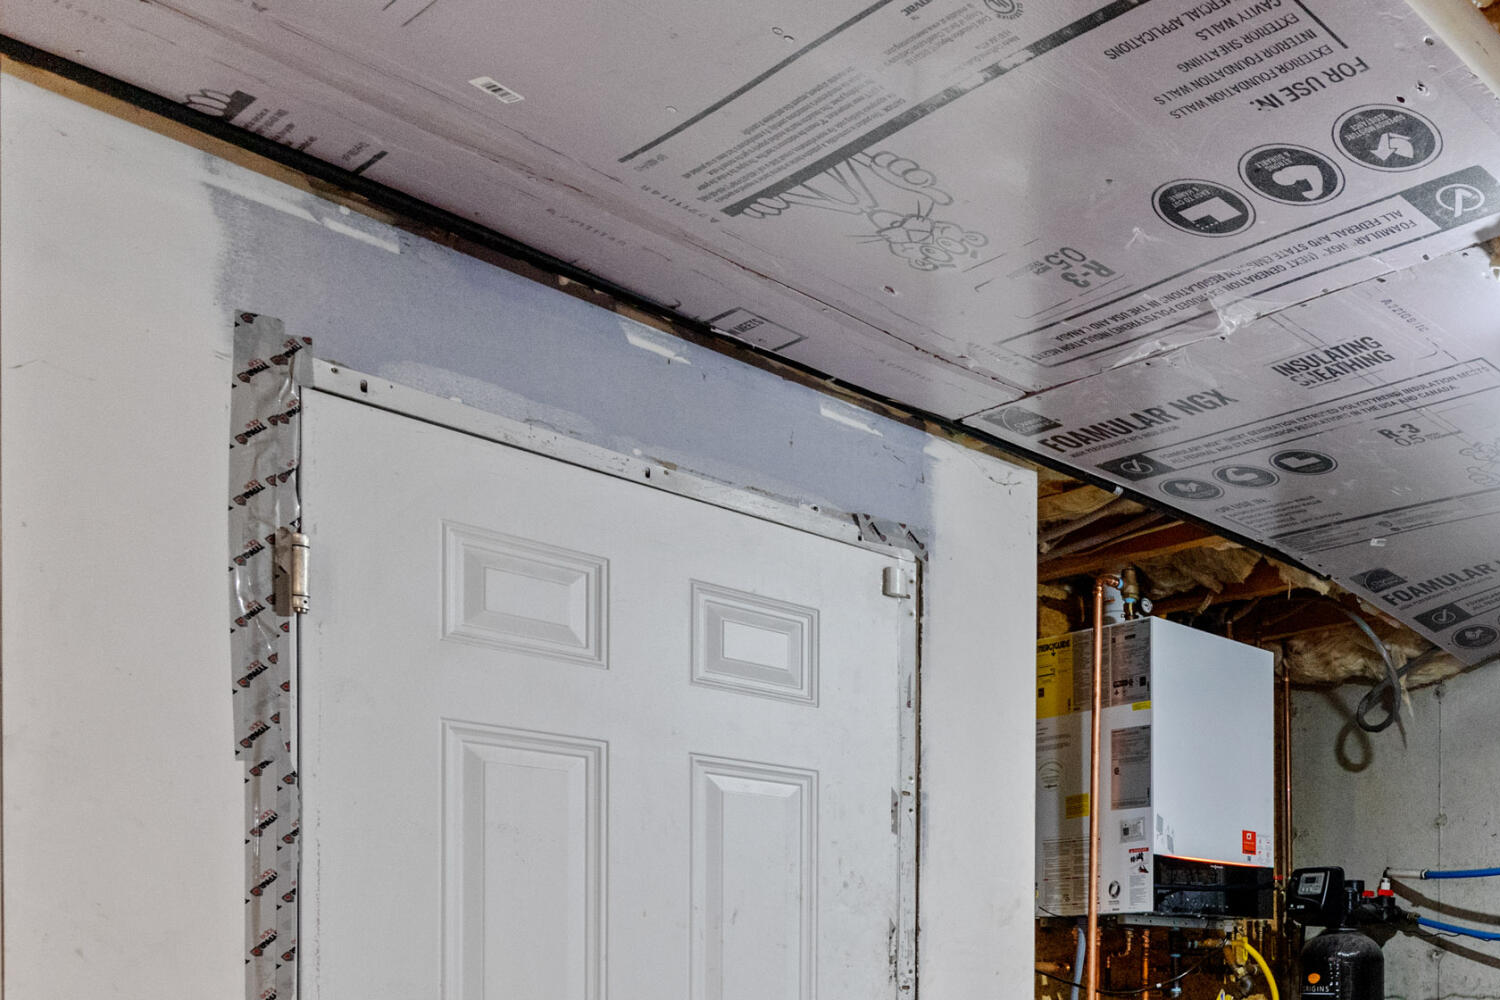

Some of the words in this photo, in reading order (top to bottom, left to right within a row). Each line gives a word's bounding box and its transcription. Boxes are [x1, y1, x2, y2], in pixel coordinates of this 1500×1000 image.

[1180, 1, 1230, 21] ERCIAL
[1235, 0, 1281, 21] CAVITY
[1103, 17, 1184, 60] APPLICATIONS
[1194, 16, 1238, 40] WALLS
[1239, 11, 1299, 43] EXTERIOR
[1176, 38, 1242, 72] SHEATHING
[1260, 28, 1317, 57] INTERIOR
[1189, 52, 1263, 89] FOUNDATION
[1274, 43, 1333, 73] EXTERIOR
[1321, 55, 1369, 85] FOR
[1152, 83, 1192, 104] WALLS
[1204, 68, 1277, 104] FOUNDATION
[1278, 74, 1325, 102] USE
[1168, 98, 1207, 119] WALLS
[1249, 91, 1283, 113] IN:
[1170, 198, 1185, 208] CUT
[1380, 208, 1403, 222] ALL
[1330, 215, 1380, 240] FEDERAL
[1044, 245, 1086, 270] 0.5
[1272, 241, 1307, 261] STATE
[1060, 260, 1115, 289] R-3
[1224, 262, 1286, 293] GENERATION
[1109, 310, 1131, 325] USA
[1129, 302, 1151, 316] THE
[1271, 334, 1382, 377] INSULATING
[1290, 347, 1395, 387] SHEATHING
[1168, 387, 1238, 418] NGX
[1376, 422, 1420, 438] R-3
[1394, 434, 1425, 446] 0.5
[1382, 563, 1496, 605] FOAMULAR
